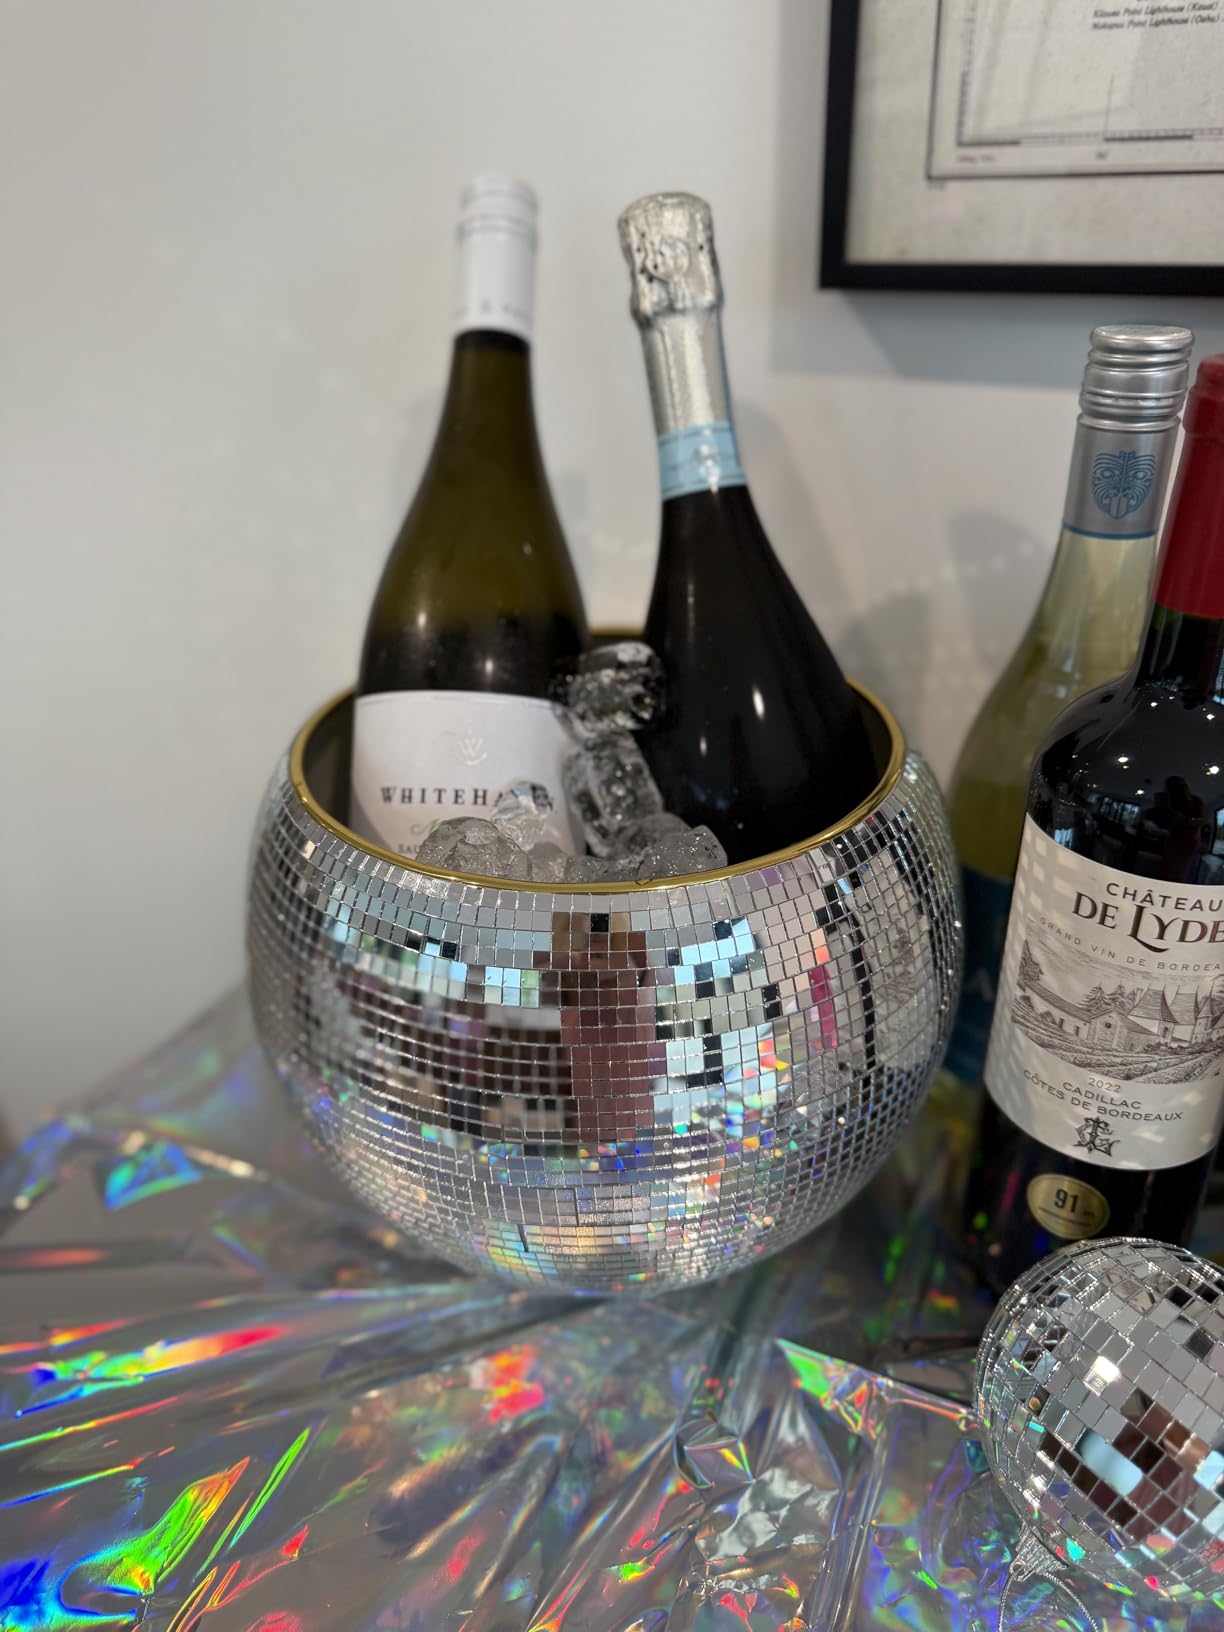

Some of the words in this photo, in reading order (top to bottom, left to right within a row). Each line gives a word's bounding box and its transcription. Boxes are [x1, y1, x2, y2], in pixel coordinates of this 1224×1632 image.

[1144, 4, 1185, 17] Lighthouse
[1149, 16, 1189, 29] Lighthouse
[381, 786, 553, 811] WHITEH
[1072, 891, 1119, 930] DE
[1106, 882, 1223, 912] CHÂTEAU
[1040, 917, 1081, 945] GRAND
[1090, 944, 1116, 959] VIN
[1126, 956, 1146, 967] DE
[1157, 961, 1221, 972] BORDEA
[1023, 1069, 1065, 1100] CÔTES
[1070, 1097, 1091, 1111] DE
[1097, 1105, 1184, 1122] BORDEAUX
[1062, 1081, 1142, 1110] CADILLAC
[1088, 1077, 1121, 1093] 2022
[1054, 1188, 1080, 1213] 91
